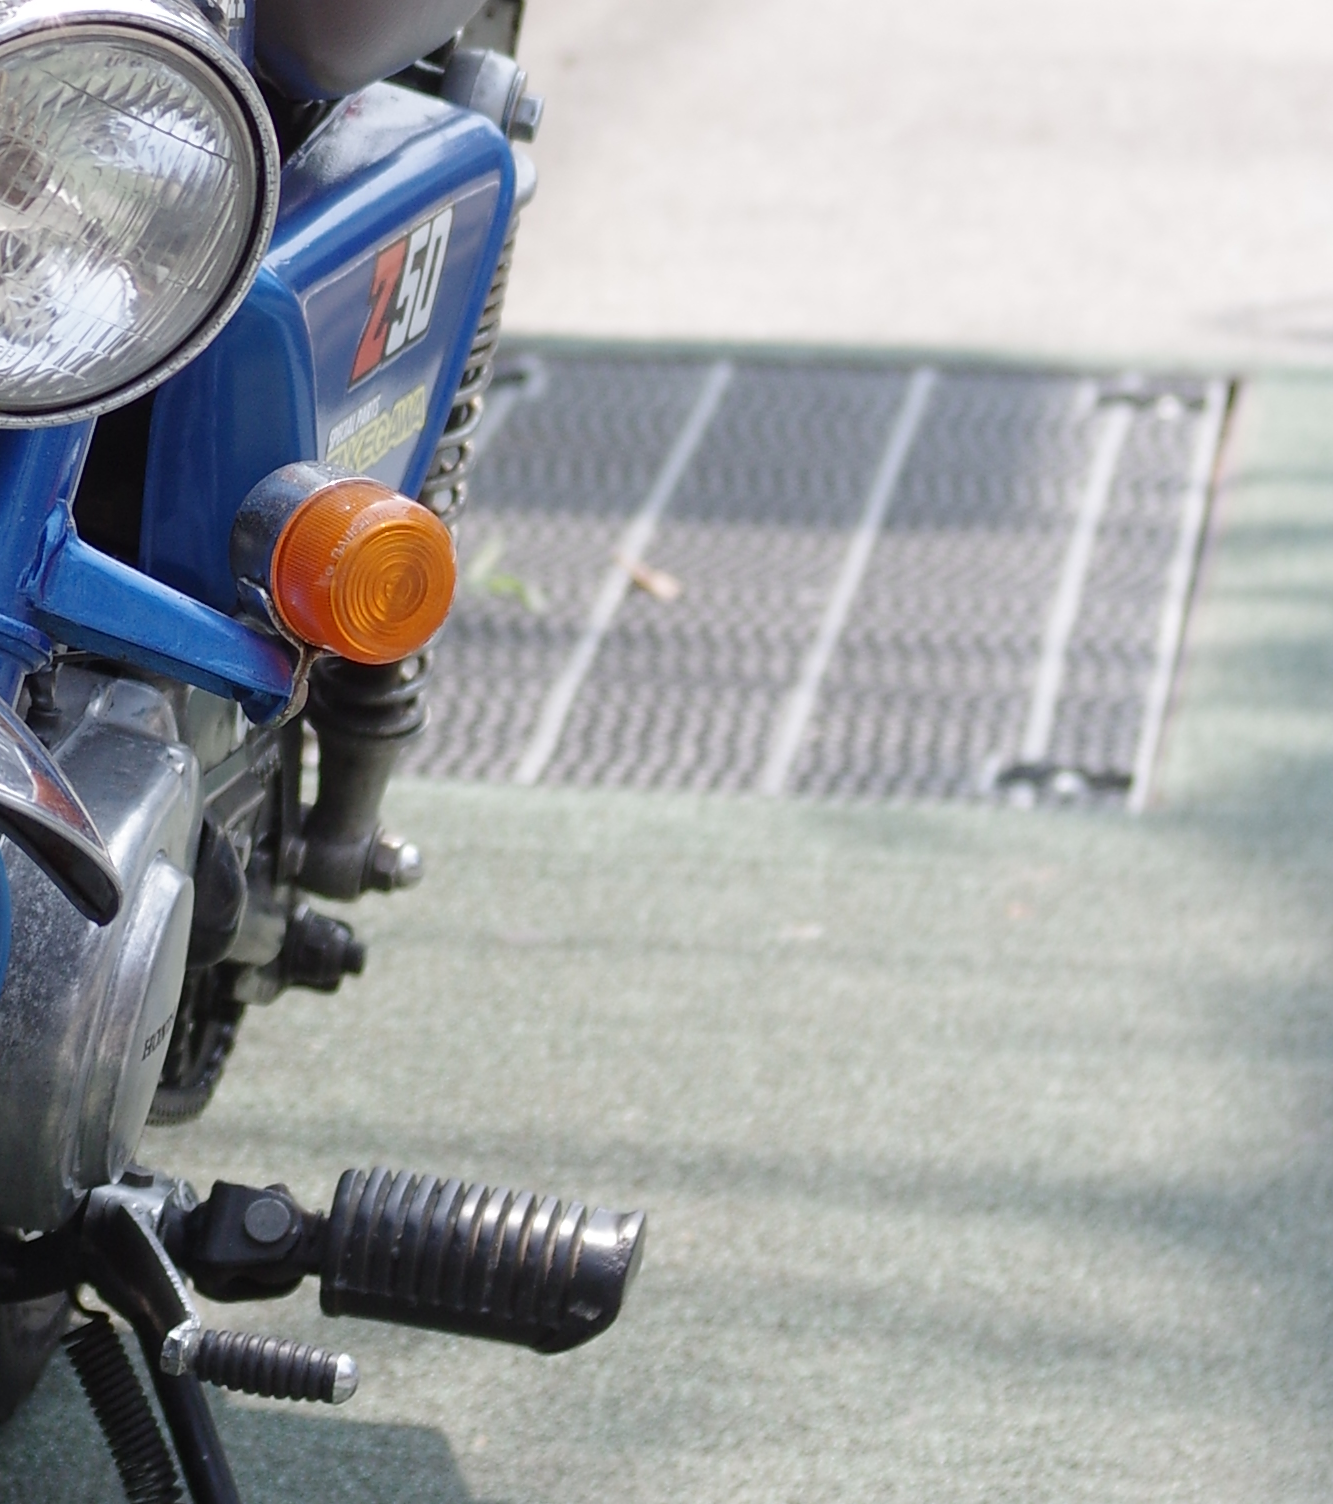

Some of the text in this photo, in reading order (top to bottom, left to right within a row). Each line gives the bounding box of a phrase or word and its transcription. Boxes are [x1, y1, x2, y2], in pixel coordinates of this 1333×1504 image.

[348, 206, 454, 388] Z50
[327, 393, 382, 454] SPECIAL PARTS
